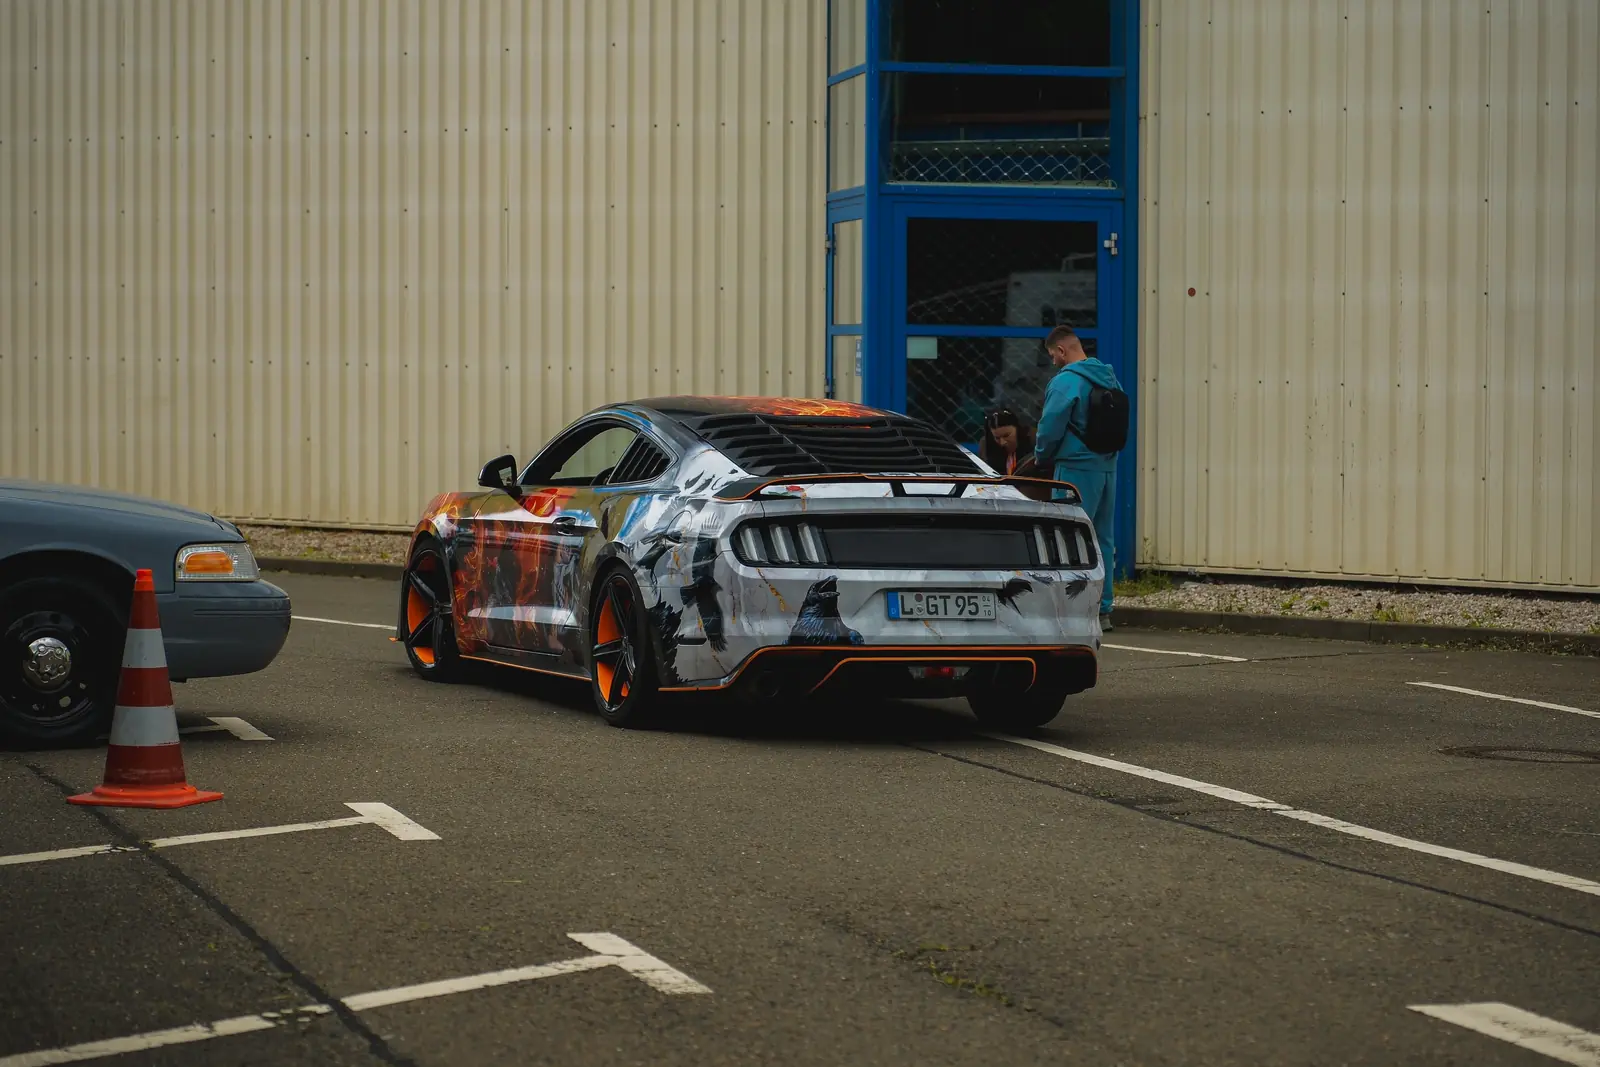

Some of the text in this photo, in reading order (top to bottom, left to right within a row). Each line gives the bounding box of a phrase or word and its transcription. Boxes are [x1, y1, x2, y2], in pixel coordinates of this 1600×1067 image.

[900, 595, 980, 616] L GT 95
